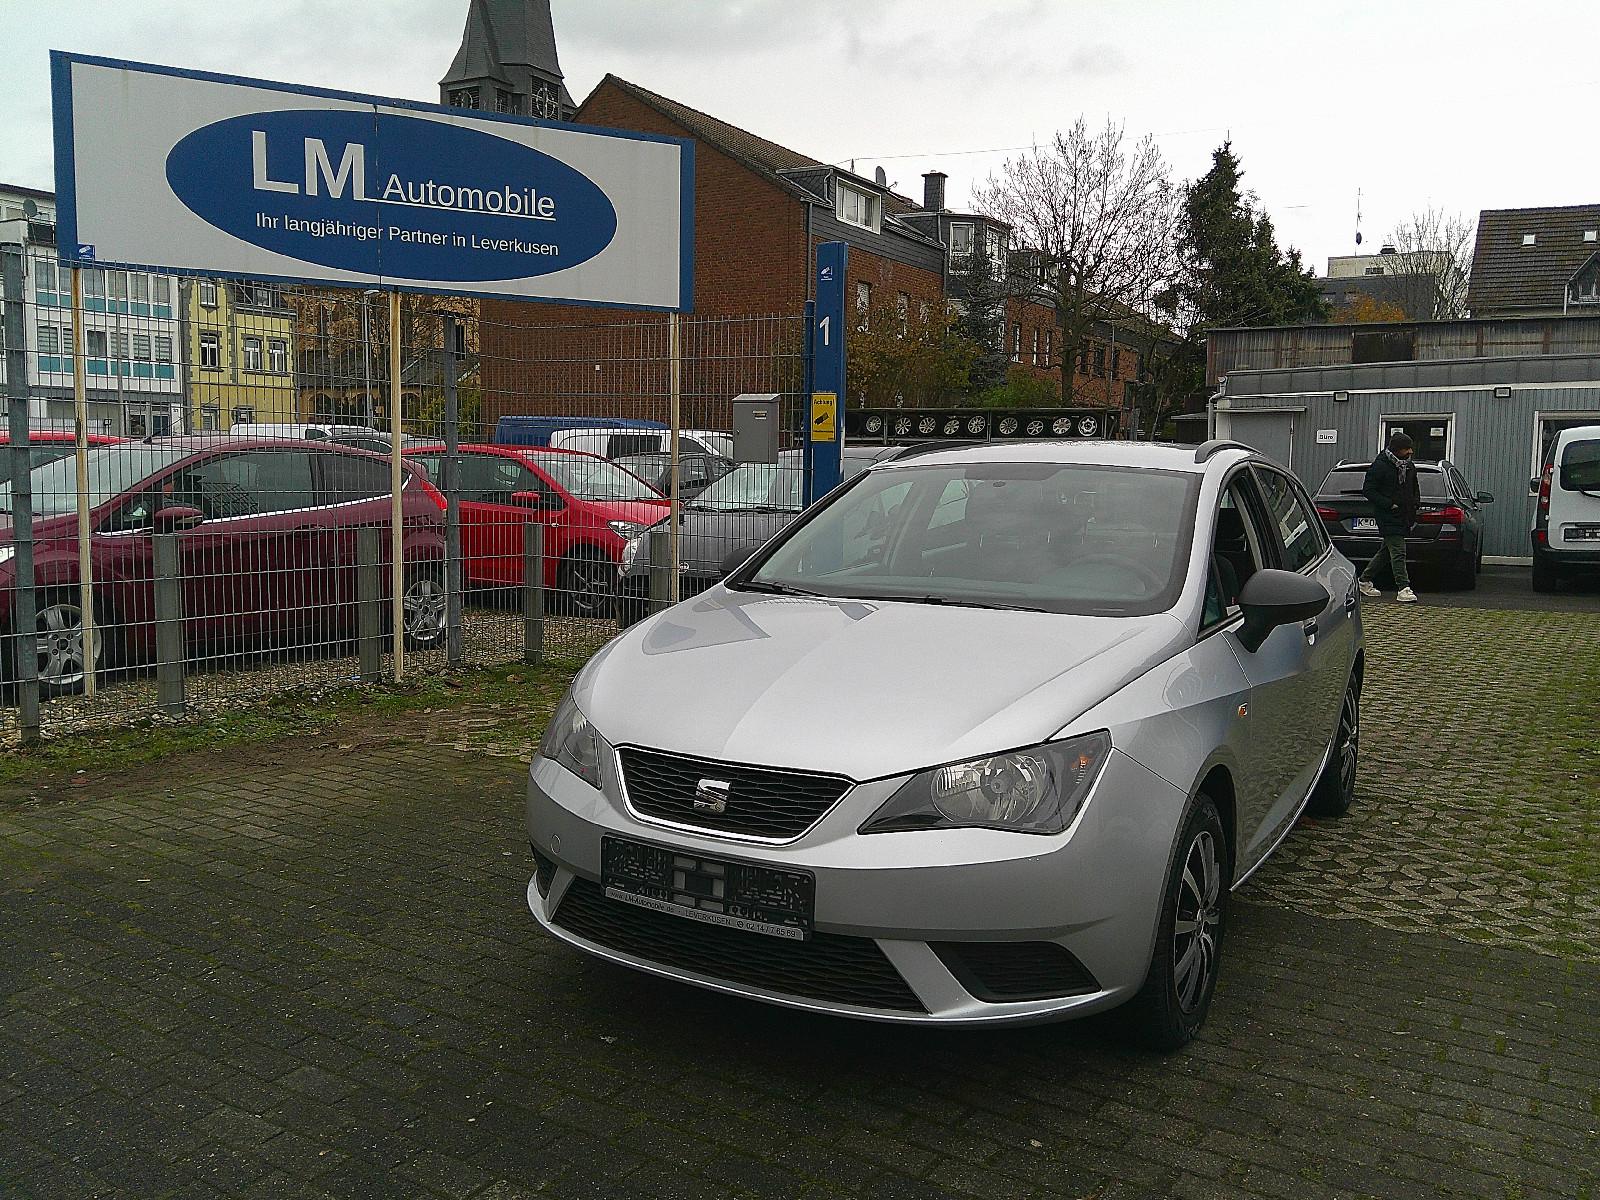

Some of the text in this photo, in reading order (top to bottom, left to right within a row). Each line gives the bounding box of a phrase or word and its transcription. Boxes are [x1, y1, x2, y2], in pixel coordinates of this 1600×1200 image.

[252, 130, 555, 217] LM Automobile
[256, 212, 559, 256] Ihr langjähriger Partner in Leverkusen
[819, 315, 830, 346] 1
[684, 909, 732, 926] LEVERKUSEN
